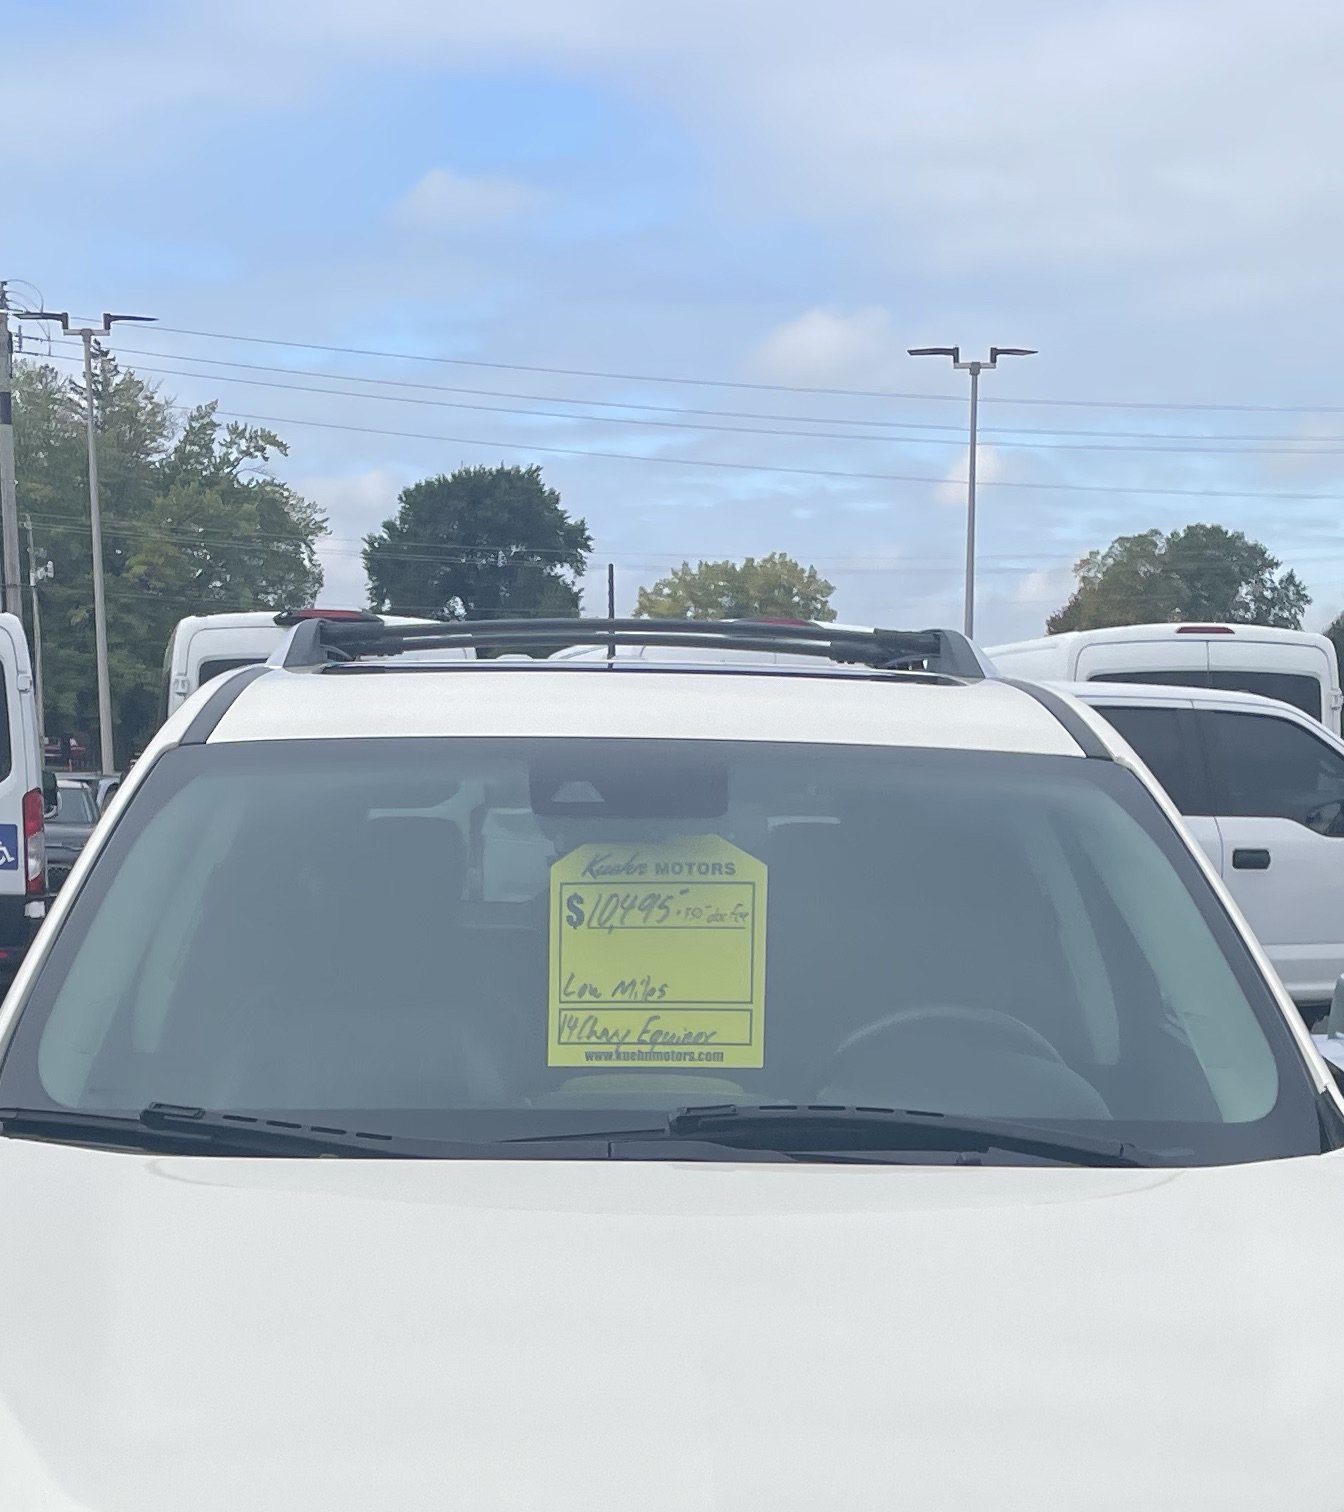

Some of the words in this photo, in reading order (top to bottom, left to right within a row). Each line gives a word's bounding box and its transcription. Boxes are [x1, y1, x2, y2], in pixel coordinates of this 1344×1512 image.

[655, 861, 737, 877] MOTORS
[563, 971, 603, 999] Low
[611, 974, 671, 1001] Miles
[577, 1014, 632, 1052] Chevy
[636, 1014, 718, 1050] Equinox
[584, 1049, 725, 1063] www.kuehnmotors.com
